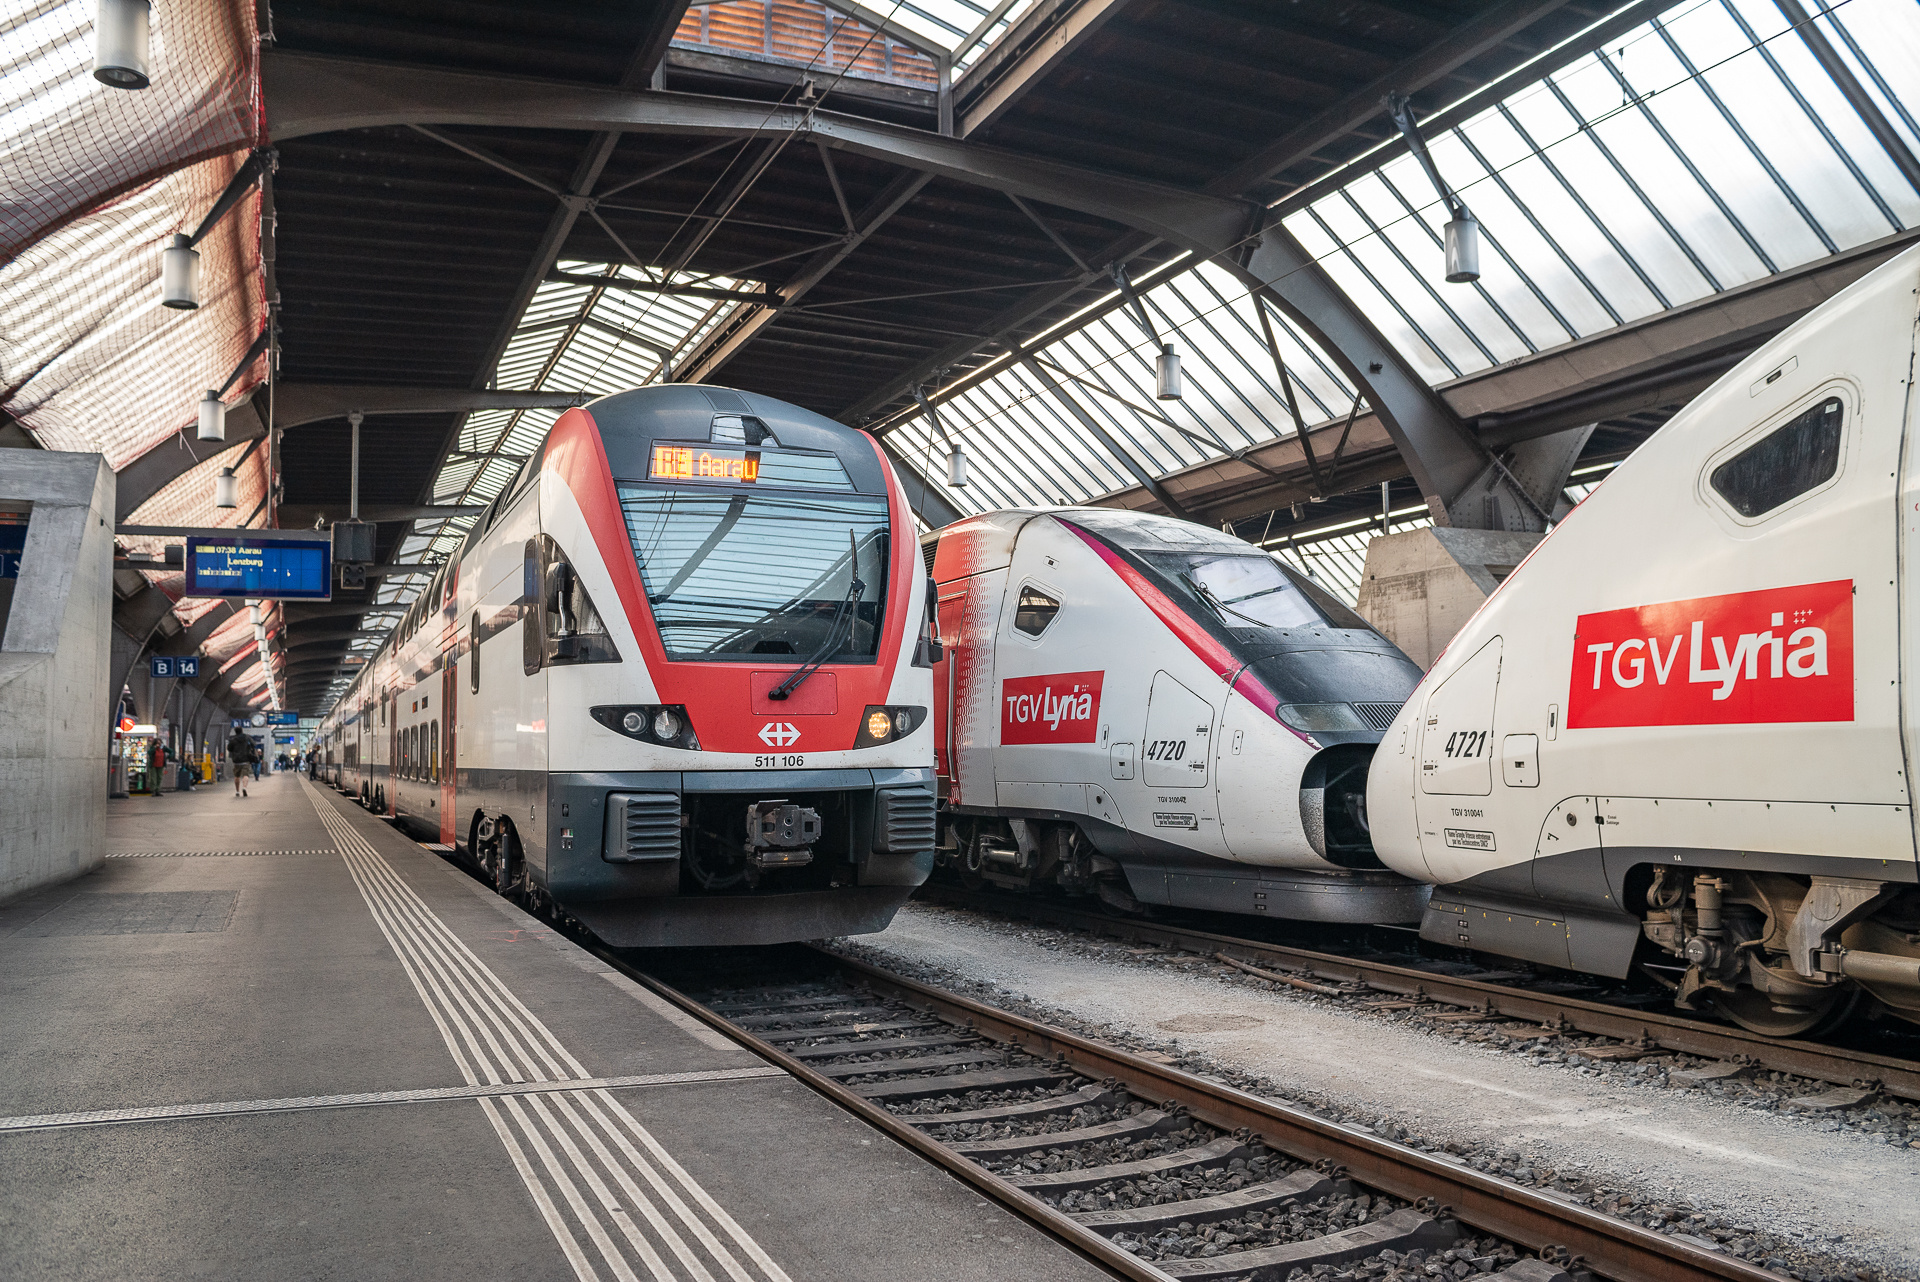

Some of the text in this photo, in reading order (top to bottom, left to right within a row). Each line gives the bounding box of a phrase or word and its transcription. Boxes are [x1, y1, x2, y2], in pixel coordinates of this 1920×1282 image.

[699, 452, 757, 479] Aarau
[216, 546, 236, 554] 07:38
[238, 546, 262, 555] Aarau
[228, 557, 263, 567] Lenzburg
[1587, 611, 1829, 701] TGV Lyria
[157, 663, 168, 674] B
[180, 662, 195, 674] 14
[1006, 684, 1092, 731] TGV Lyria
[1147, 740, 1186, 761] 4720
[1445, 730, 1487, 758] 4721
[754, 755, 804, 767] 511 106
